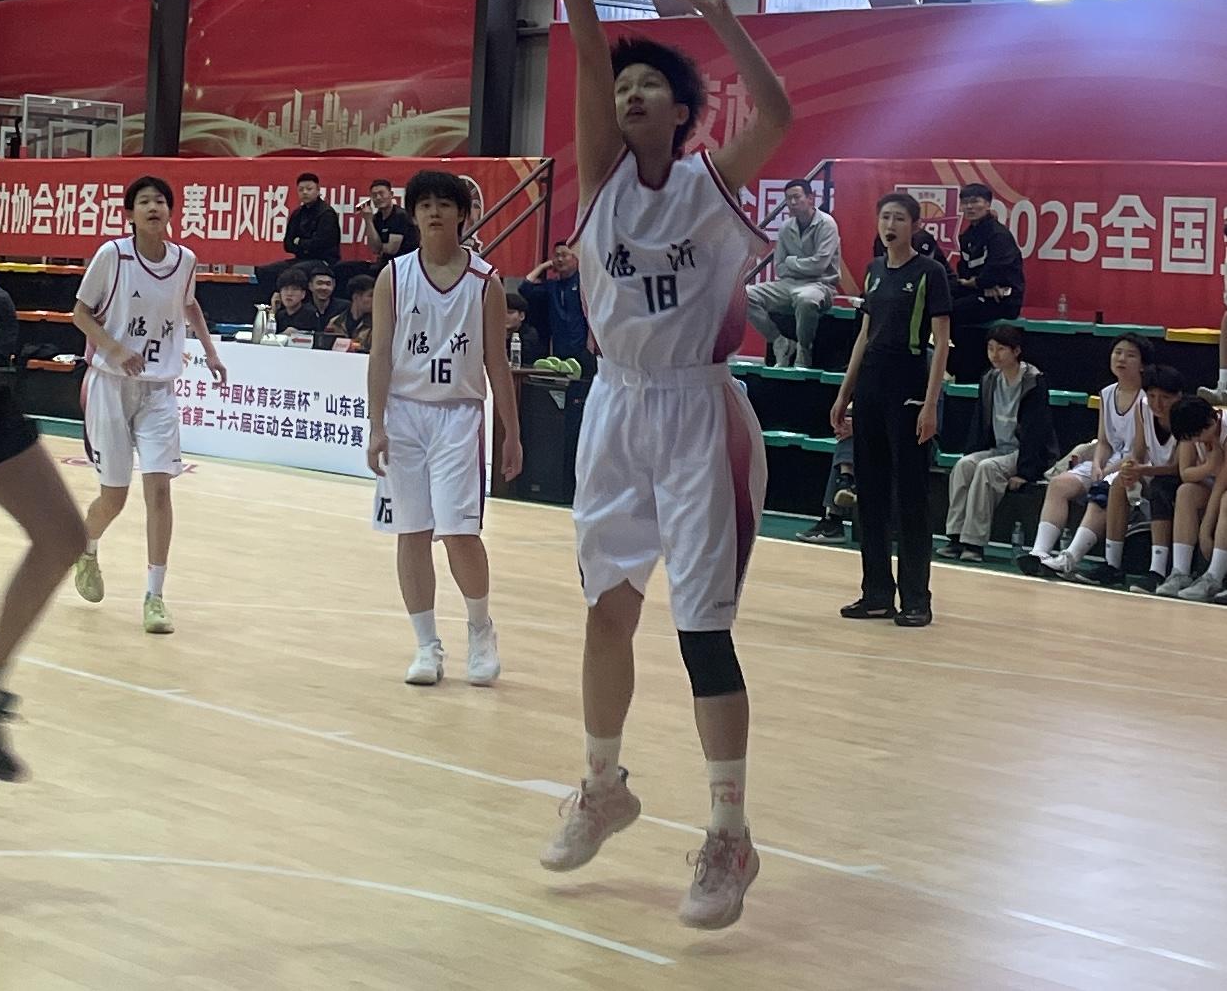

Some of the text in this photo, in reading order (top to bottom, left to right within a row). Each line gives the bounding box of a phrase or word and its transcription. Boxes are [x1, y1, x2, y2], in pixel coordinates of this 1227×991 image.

[991, 194, 1227, 275] 025全国
[606, 239, 696, 279] 临沂
[642, 274, 678, 315] 18
[407, 331, 470, 357] 临沂
[430, 358, 452, 384] 16
[178, 405, 364, 448] 省第二十六届运动会篮球积分赛
[325, 393, 370, 420] 山东省
